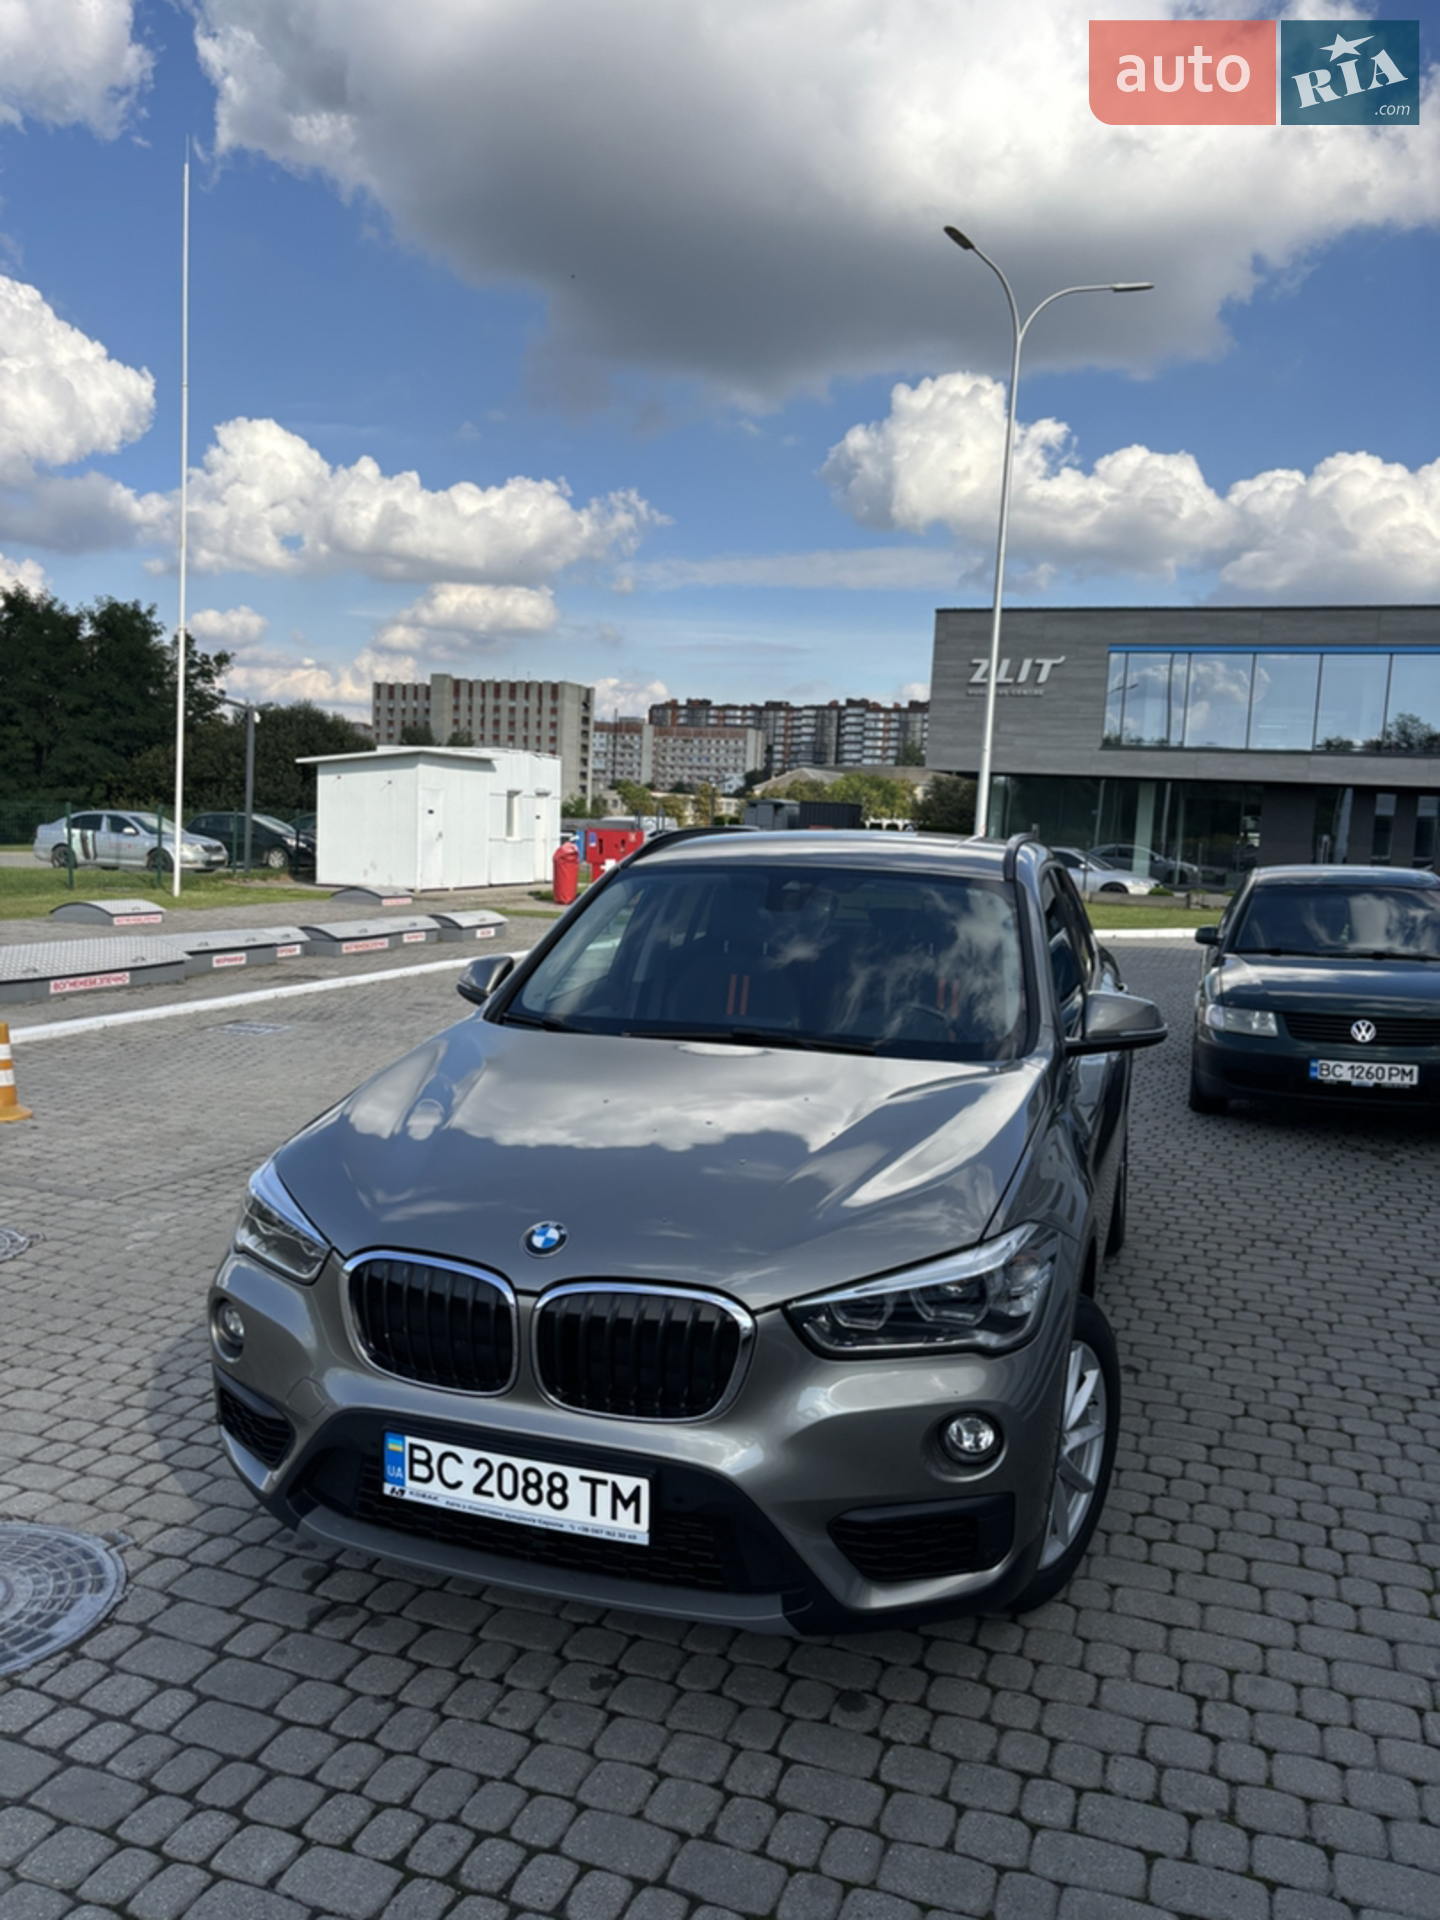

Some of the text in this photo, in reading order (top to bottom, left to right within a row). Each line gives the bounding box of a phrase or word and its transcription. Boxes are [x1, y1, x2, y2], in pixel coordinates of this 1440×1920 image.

[969, 655, 1066, 683] ZLIT
[1319, 1063, 1414, 1082] BC 1260 PM
[387, 1465, 403, 1479] UA
[408, 1443, 463, 1490] BC
[473, 1458, 569, 1511] 2088
[579, 1475, 641, 1525] TM
